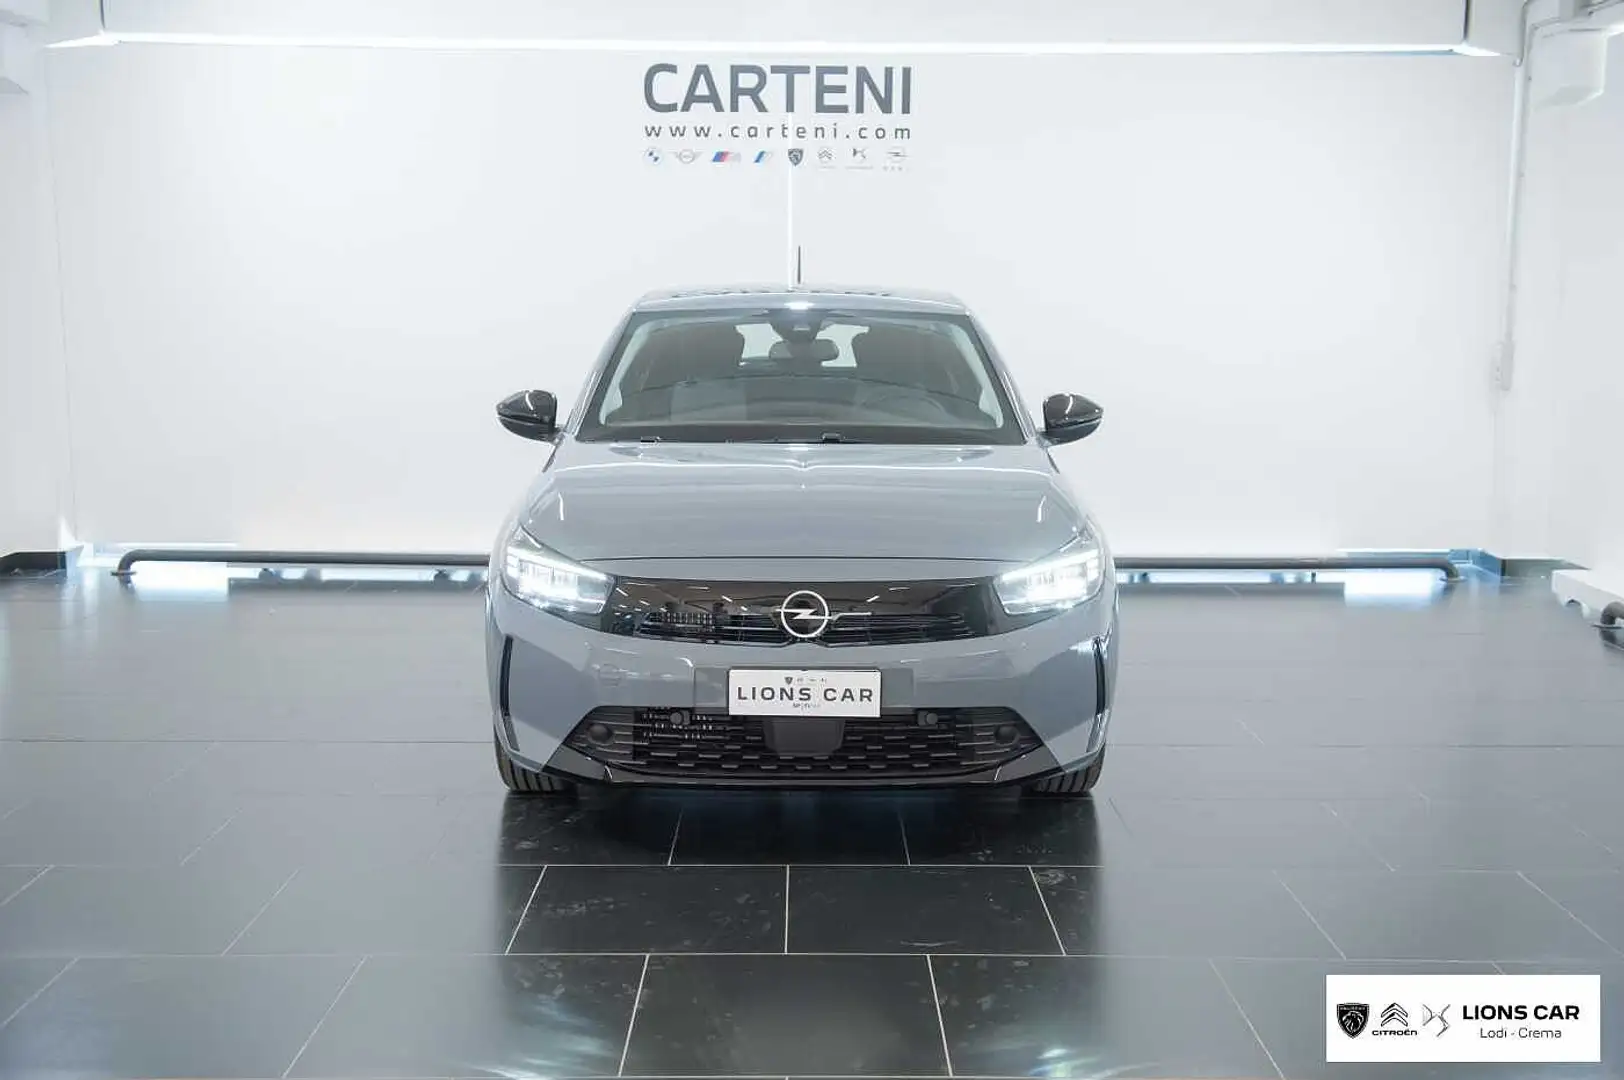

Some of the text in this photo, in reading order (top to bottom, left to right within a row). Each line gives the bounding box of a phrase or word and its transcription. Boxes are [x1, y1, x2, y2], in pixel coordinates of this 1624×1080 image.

[644, 63, 912, 114] CARTENI
[644, 123, 912, 140] www.carteni.com
[737, 686, 874, 702] LIONS CAR
